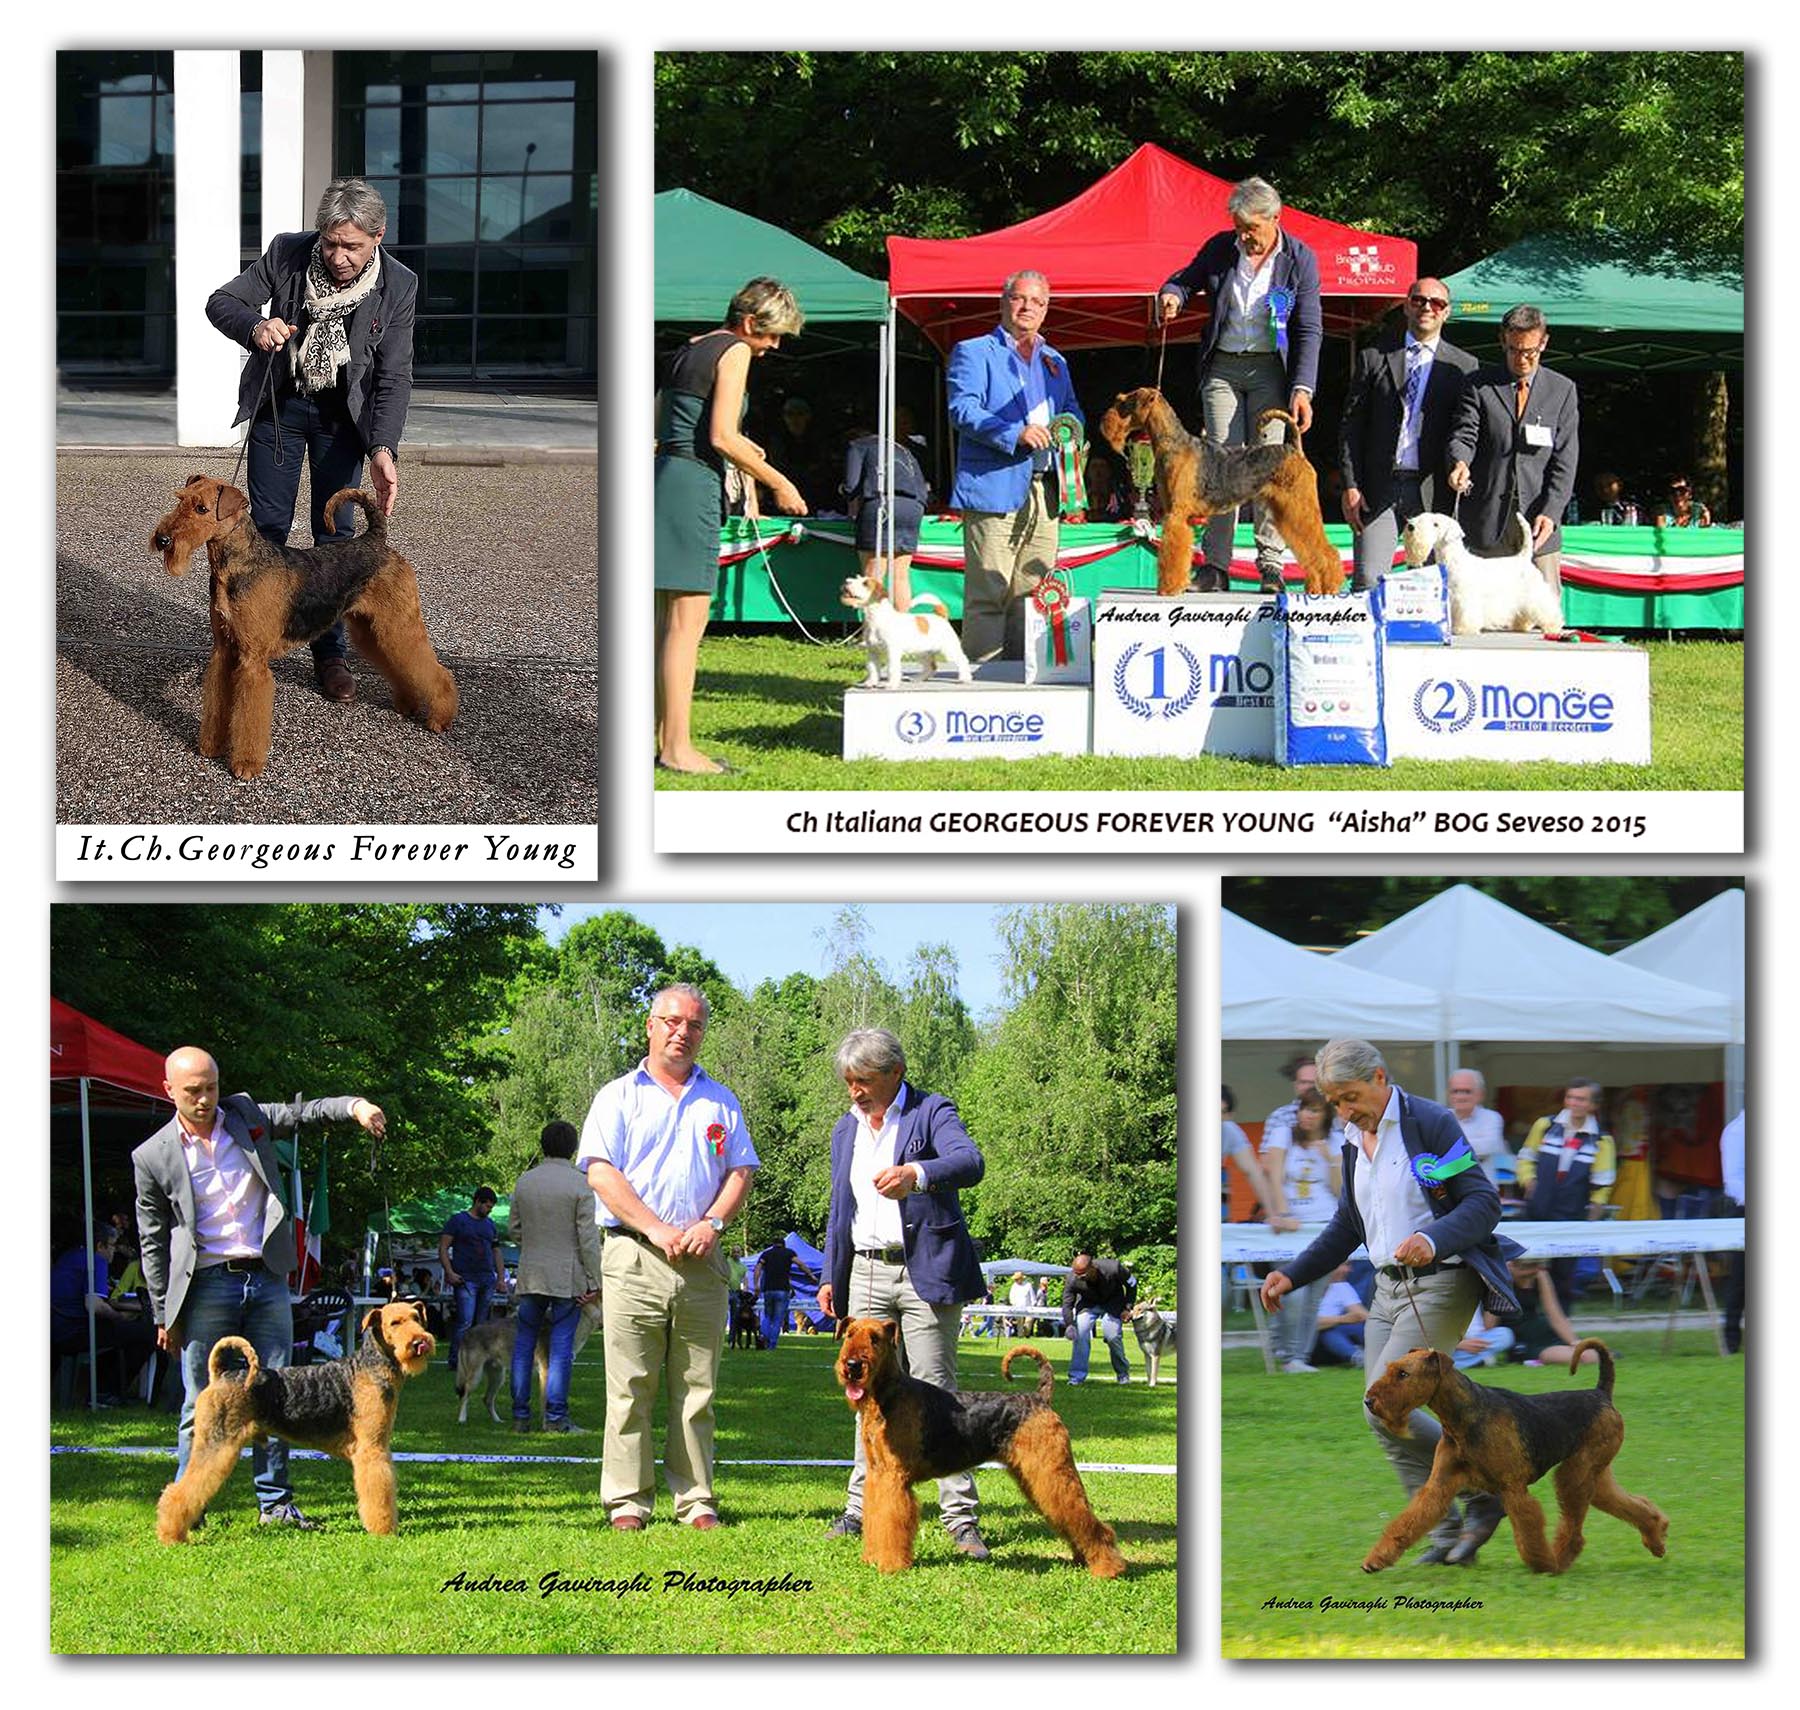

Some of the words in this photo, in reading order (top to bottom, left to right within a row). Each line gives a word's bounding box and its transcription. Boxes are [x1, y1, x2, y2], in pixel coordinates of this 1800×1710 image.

[1142, 645, 1173, 700] 1
[1431, 680, 1460, 720] 2
[907, 711, 924, 737] 3
